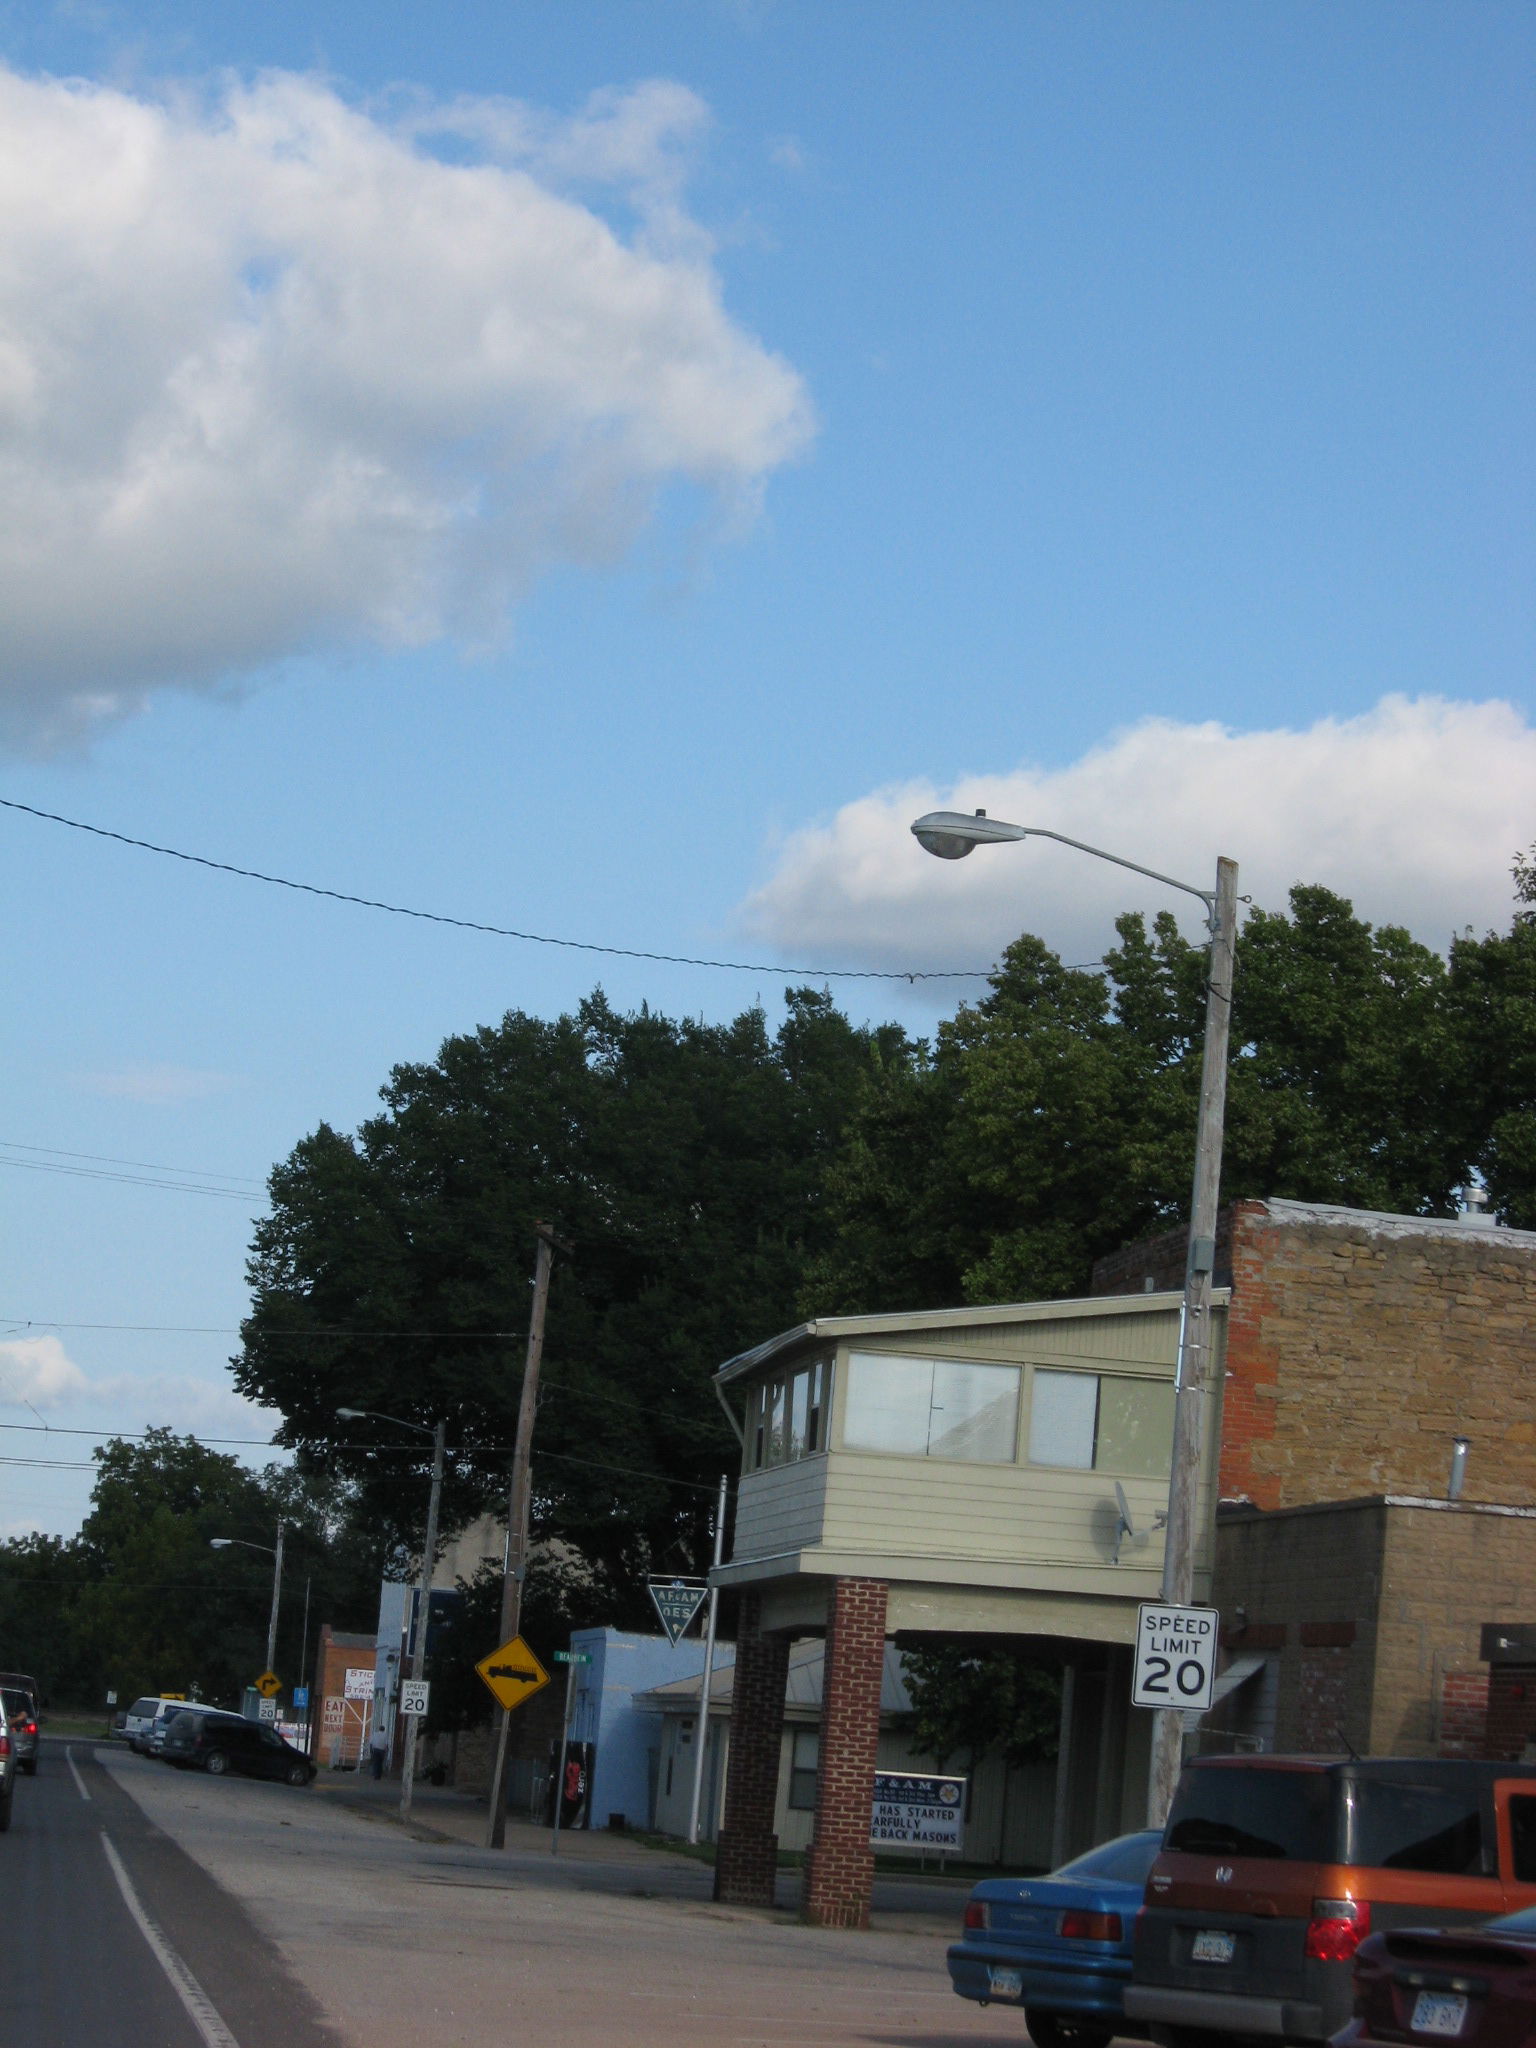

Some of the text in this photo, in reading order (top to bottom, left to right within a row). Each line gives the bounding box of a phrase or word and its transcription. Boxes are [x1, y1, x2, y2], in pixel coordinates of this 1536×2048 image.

[1145, 1615, 1211, 1635] SPEED
[1150, 1636, 1202, 1655] LIMIT
[1142, 1656, 1205, 1696] 20
[405, 1682, 427, 1690] SPEED
[325, 1699, 344, 1712] EAT
[404, 1698, 425, 1712] 20
[260, 1709, 274, 1718] 20
[324, 1713, 343, 1722] NEXT
[879, 1805, 955, 1821] HAS STARTED
[873, 1816, 920, 1830] ARFULLY
[880, 1828, 908, 1840] BACK
[912, 1831, 957, 1844] MASONS
